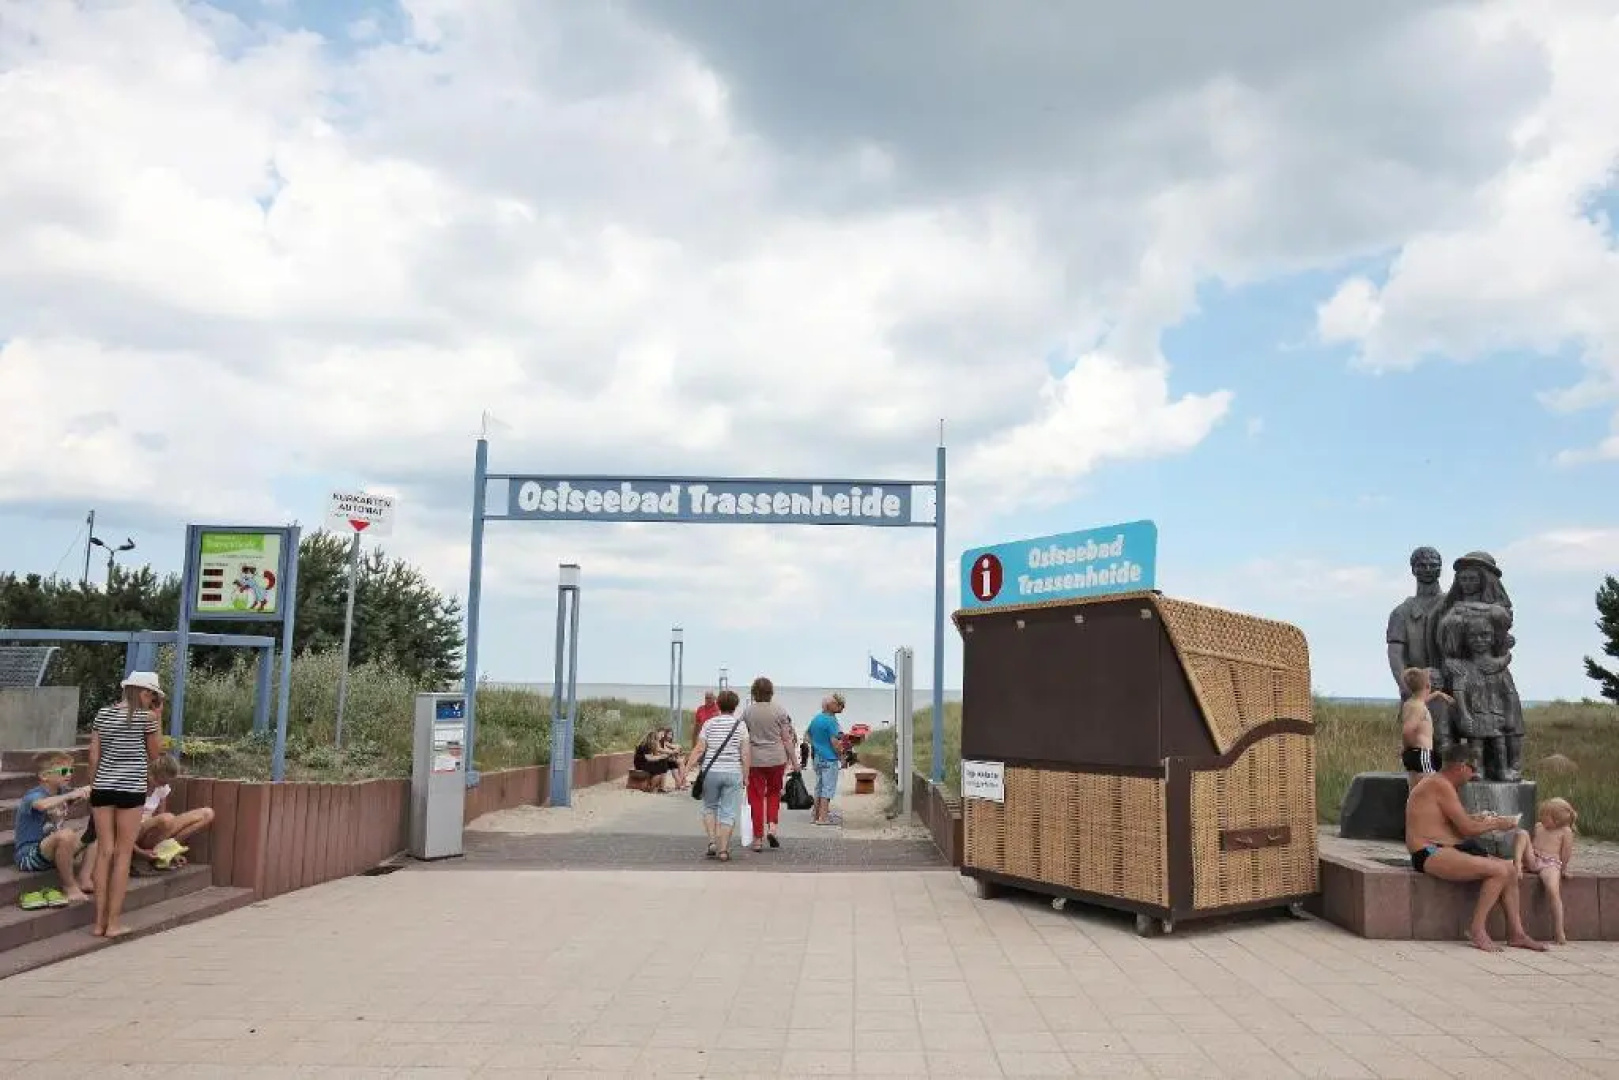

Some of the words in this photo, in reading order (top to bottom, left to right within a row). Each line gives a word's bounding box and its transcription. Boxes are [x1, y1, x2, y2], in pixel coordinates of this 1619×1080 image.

[339, 503, 383, 516] AUTOMAT
[518, 480, 681, 514] Ostseebad
[688, 484, 900, 517] Trassenheide
[1029, 534, 1125, 569] Ostseebad
[1017, 561, 1142, 595] Trassenheide
